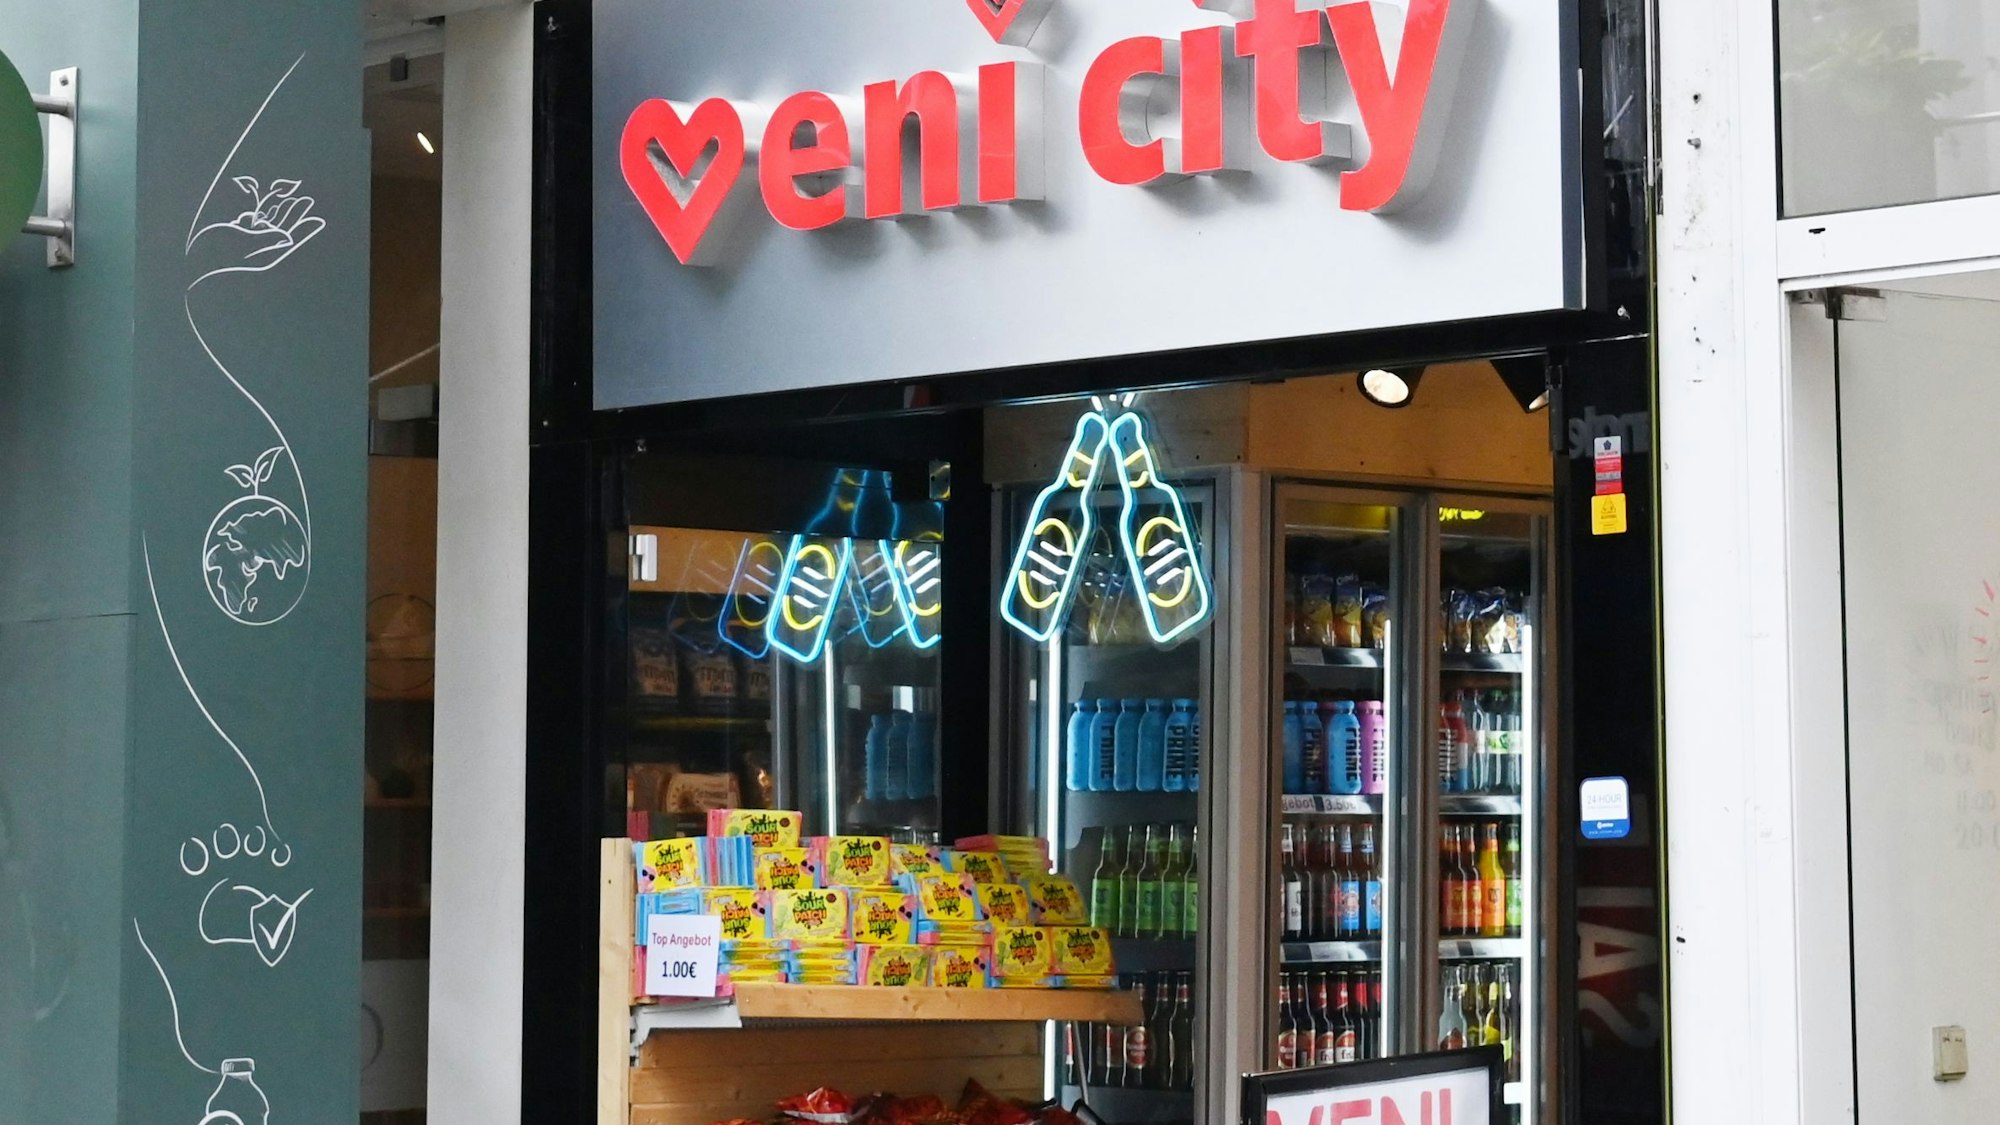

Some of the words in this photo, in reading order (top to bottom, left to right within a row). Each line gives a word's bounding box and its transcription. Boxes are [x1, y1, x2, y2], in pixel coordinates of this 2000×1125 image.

[745, 820, 778, 834] SOUR
[752, 833, 778, 845] ATCH
[656, 851, 682, 865] SOUR
[844, 847, 872, 859] SOUR
[656, 862, 684, 876] PATCH
[844, 857, 873, 869] PATCH
[794, 899, 825, 911] SOUR
[794, 910, 827, 923] PATCH
[652, 932, 668, 946] Top
[669, 933, 712, 949] Angebot
[662, 960, 698, 979] 1.00€
